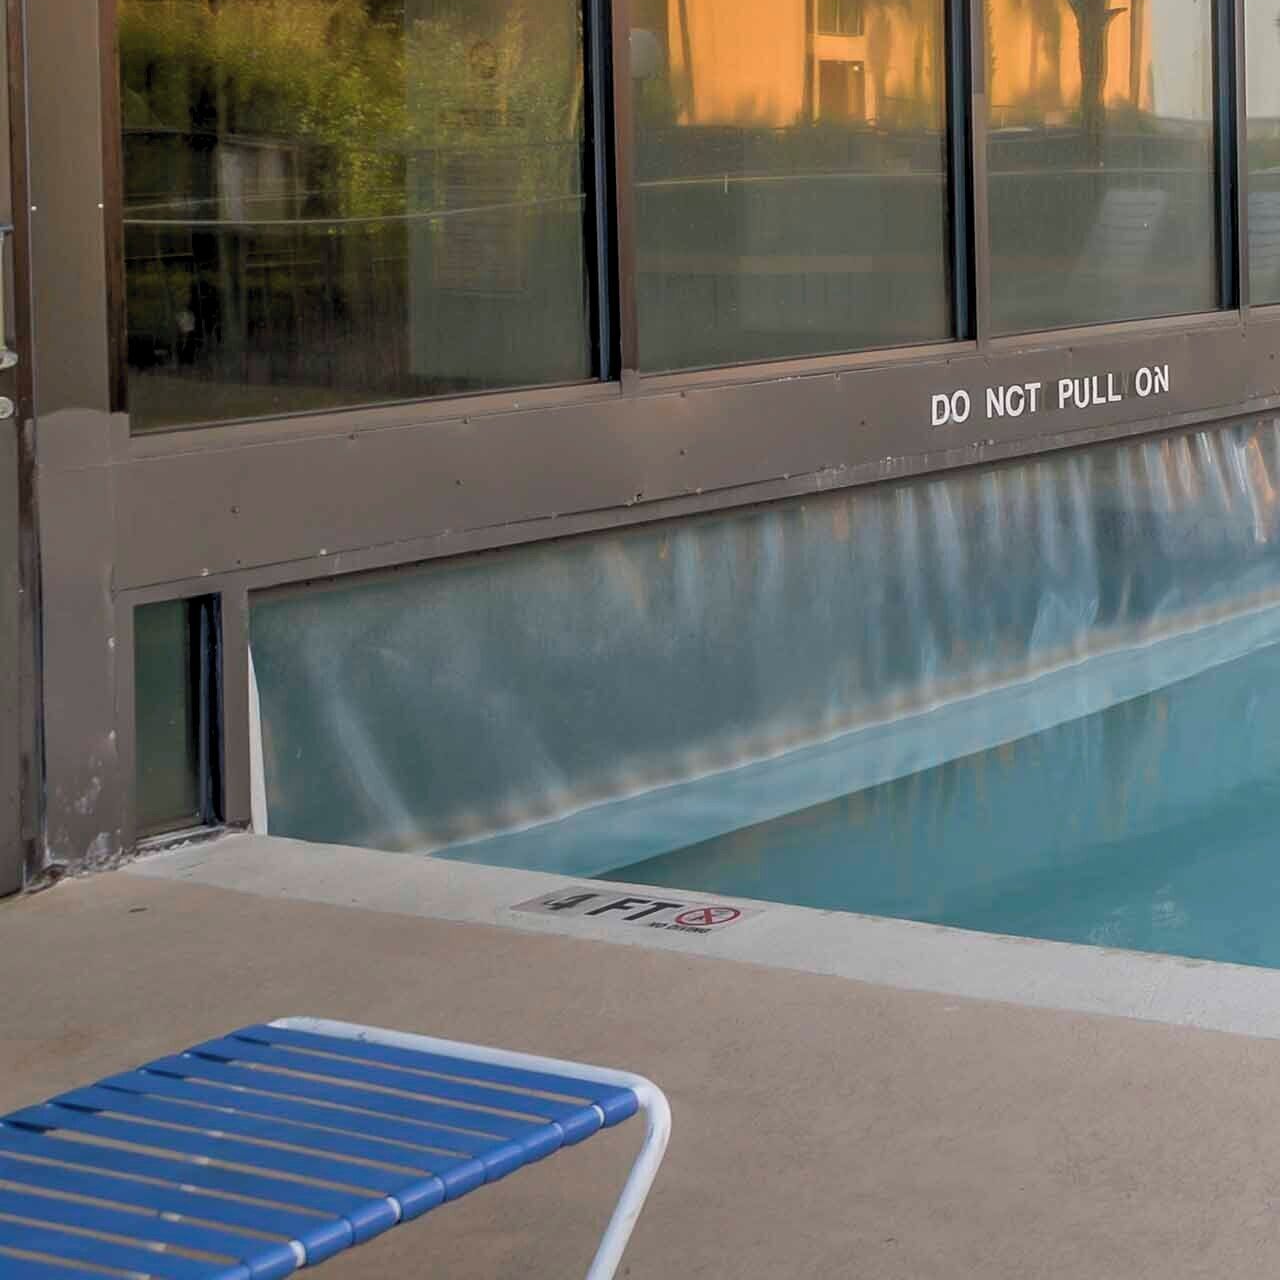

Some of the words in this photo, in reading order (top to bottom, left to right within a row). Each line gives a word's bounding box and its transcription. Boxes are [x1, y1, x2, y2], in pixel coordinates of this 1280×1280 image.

[931, 390, 970, 426] DO
[986, 382, 1041, 418] NOT
[1059, 373, 1122, 409] PULL
[1135, 364, 1169, 397] ON
[584, 897, 684, 920] FT
